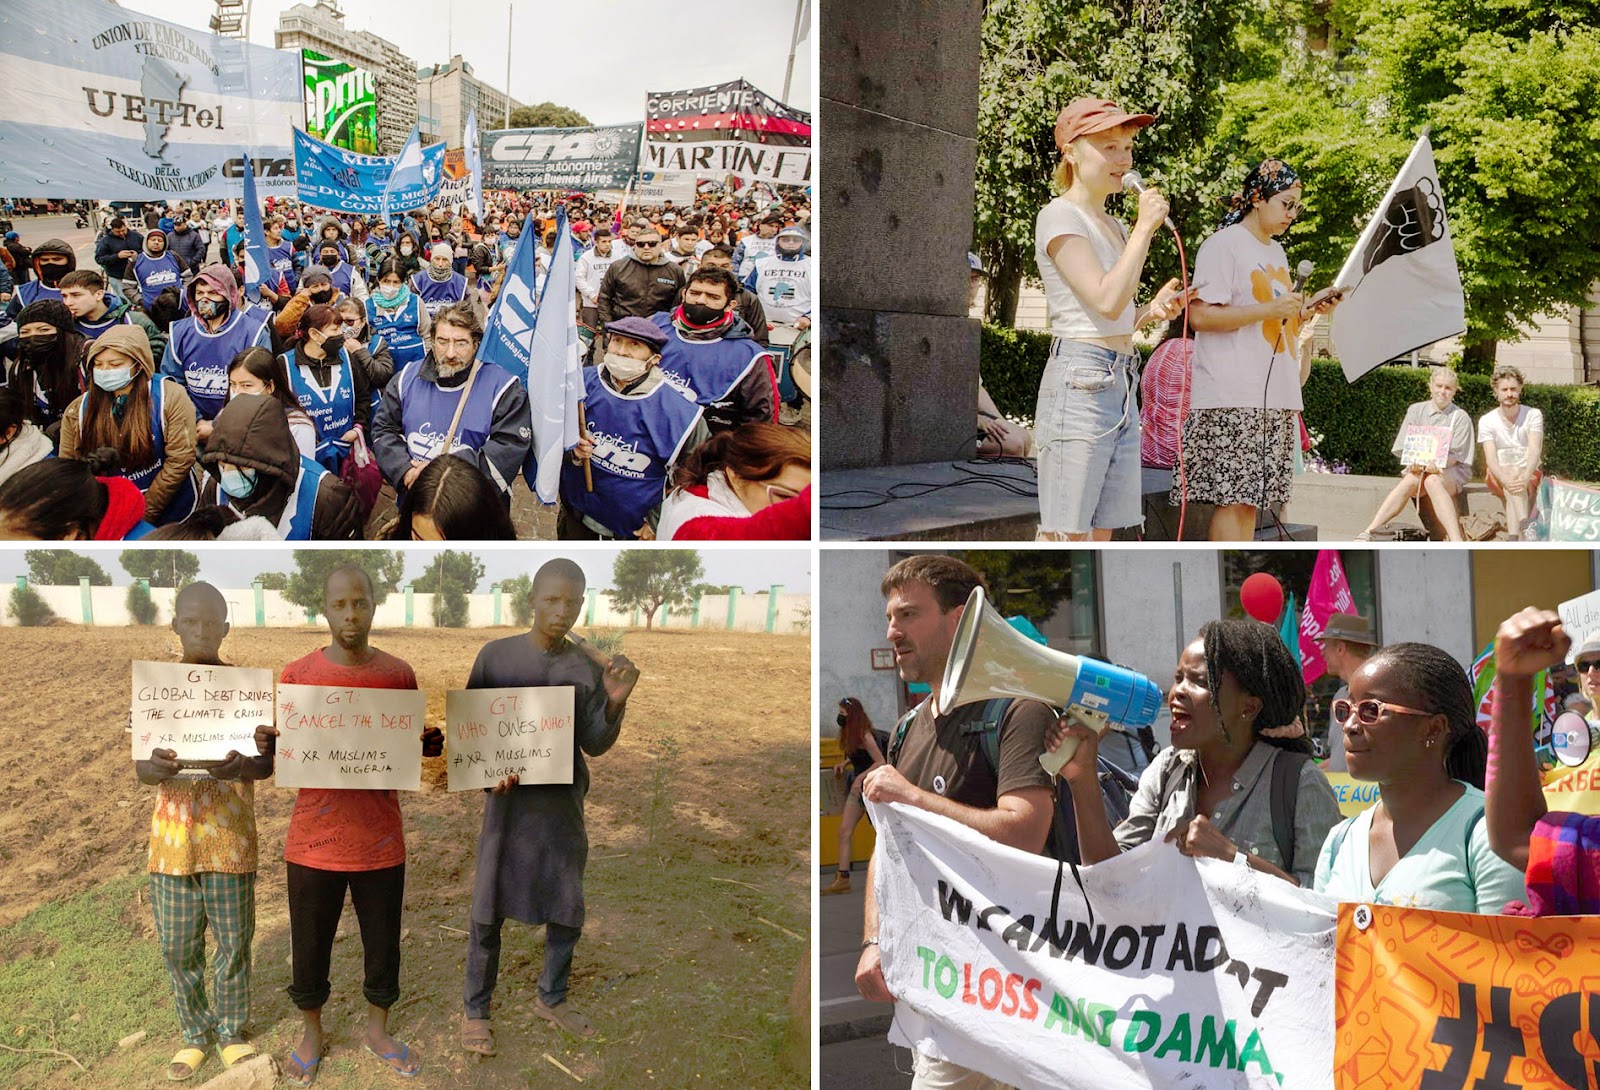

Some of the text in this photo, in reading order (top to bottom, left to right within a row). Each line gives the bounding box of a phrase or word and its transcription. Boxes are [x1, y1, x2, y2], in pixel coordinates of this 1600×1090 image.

[91, 21, 220, 76] UNION DE EMPLEADOS
[143, 42, 189, 64] TECNICOS
[82, 87, 224, 130] UETTel
[492, 133, 597, 161] CTA
[546, 160, 602, 173] autónoma
[645, 142, 766, 175] MARTÍN
[106, 157, 217, 193] TELECOMUNICACIONES
[155, 167, 181, 177] DE LAS
[494, 172, 613, 185] Provincia de Buenos Aires
[500, 333, 530, 367] trabajado
[188, 361, 229, 377] Capital
[298, 394, 312, 402] CTA
[138, 686, 272, 702] GLOBAL DEBT DRIVES
[141, 708, 263, 720] THE CLIMATE CRISIS
[352, 714, 372, 728] THE
[381, 713, 416, 730] DEBT
[457, 715, 572, 740] WHO OWES WHO?
[159, 735, 176, 743] XR
[183, 733, 224, 743] MUSLIMS
[230, 733, 254, 741] NIGER
[302, 750, 321, 763] XR
[329, 751, 387, 761] MUSLIMS
[495, 748, 552, 761] MUSLIMS
[917, 946, 959, 999] TO
[962, 963, 1042, 1022] LOSS
[1122, 1009, 1285, 1087] DAMA
